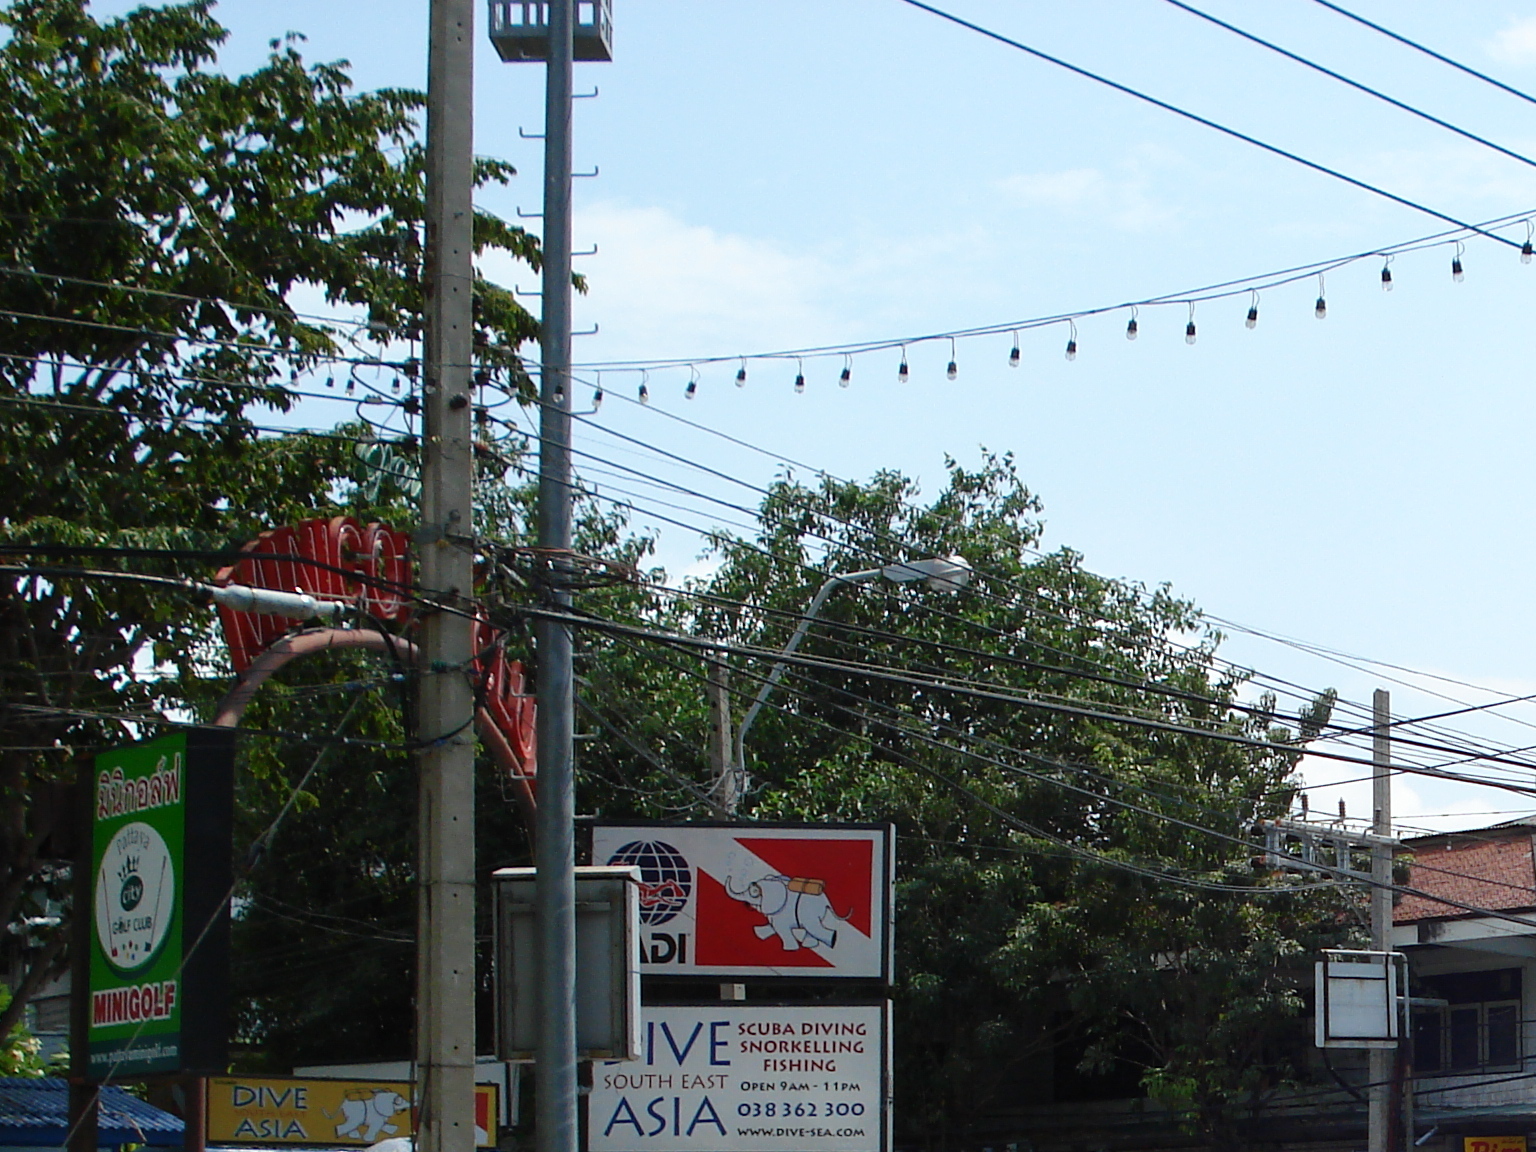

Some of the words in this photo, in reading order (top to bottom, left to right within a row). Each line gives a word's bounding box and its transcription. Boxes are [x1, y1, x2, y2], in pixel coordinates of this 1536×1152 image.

[133, 916, 152, 932] CLUB
[93, 982, 176, 1026] MINIGOLF
[737, 1022, 796, 1037] SCUBA
[800, 1022, 867, 1037] DIVING
[604, 1021, 731, 1067] IVE
[740, 1039, 865, 1054] SNORKELLING
[763, 1058, 837, 1073] FISHING
[604, 1074, 673, 1090] SOUTH
[681, 1074, 729, 1090] EAST
[232, 1086, 307, 1110] DIVE
[603, 1095, 728, 1137] ASIA
[737, 1102, 777, 1117] 038
[782, 1102, 818, 1117] 362
[824, 1102, 865, 1117] 300
[233, 1118, 308, 1139] ASIA
